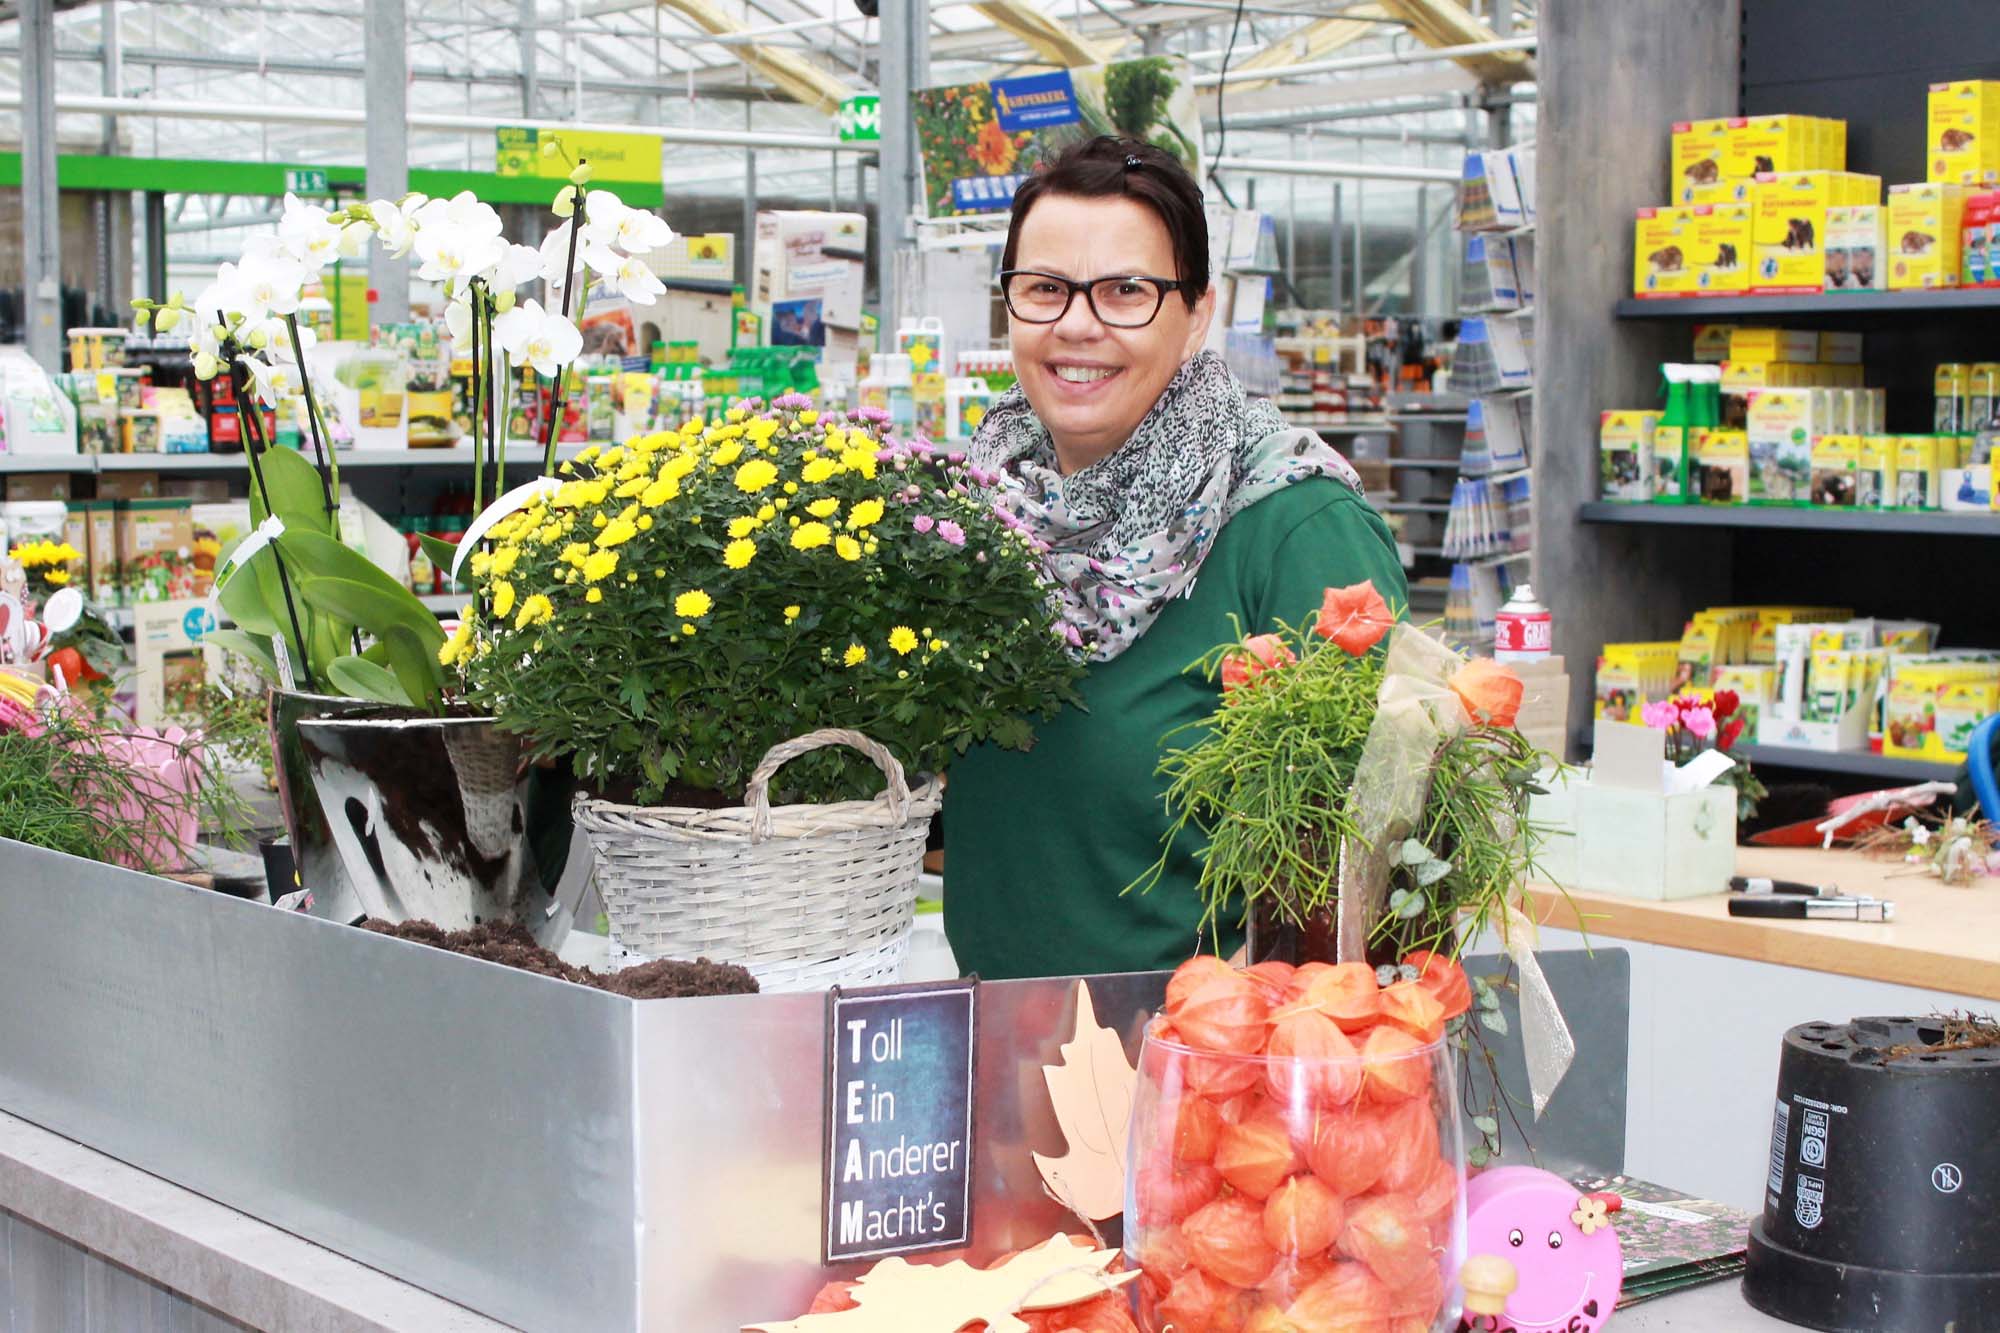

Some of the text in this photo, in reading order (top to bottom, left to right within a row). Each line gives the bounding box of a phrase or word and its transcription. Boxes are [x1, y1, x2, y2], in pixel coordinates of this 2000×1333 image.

[847, 1018, 902, 1063] Toll
[846, 1080, 895, 1124] Ein
[1804, 1123, 1825, 1138] GGN
[843, 1135, 960, 1183] Anderer
[840, 1191, 946, 1245] Macht's
